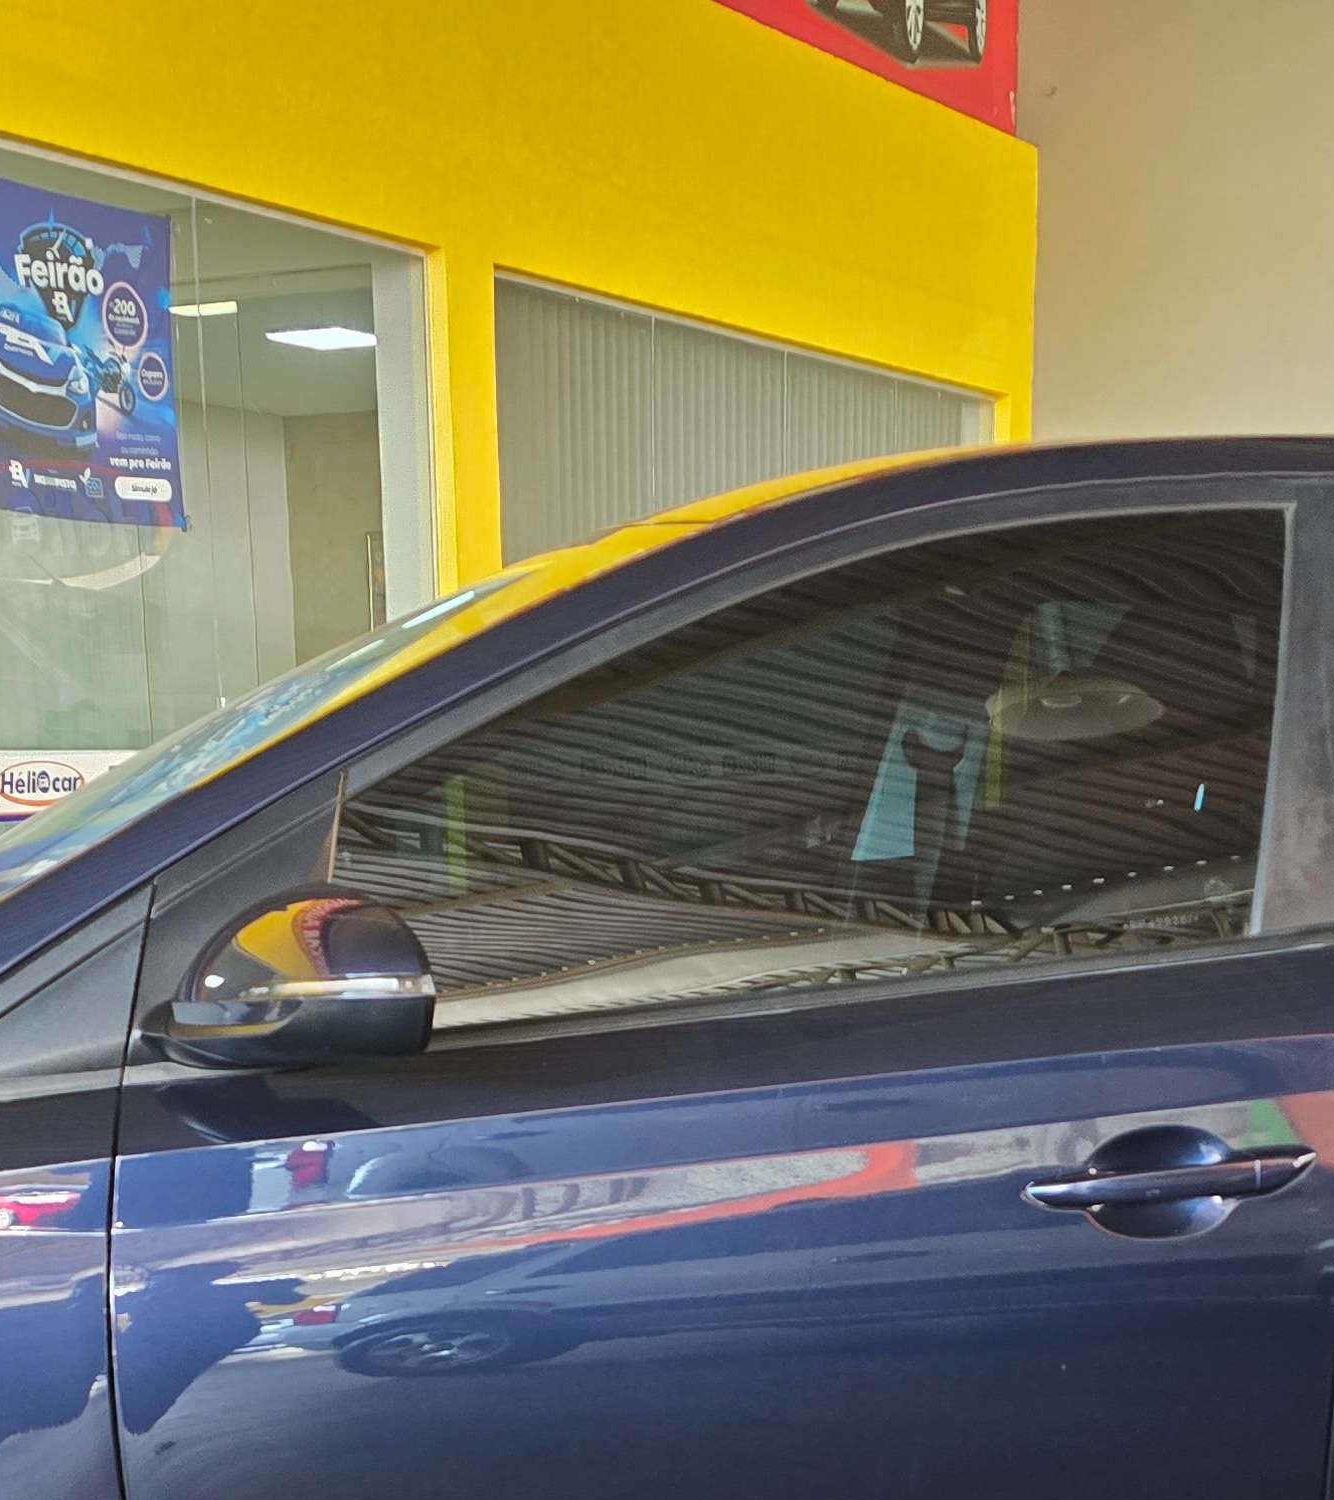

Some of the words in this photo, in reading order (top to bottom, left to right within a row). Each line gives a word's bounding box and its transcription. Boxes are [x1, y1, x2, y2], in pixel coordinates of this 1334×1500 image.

[14, 250, 104, 296] Feirão
[113, 298, 136, 317] 200
[109, 457, 128, 467] vem
[145, 457, 171, 470] Feirão
